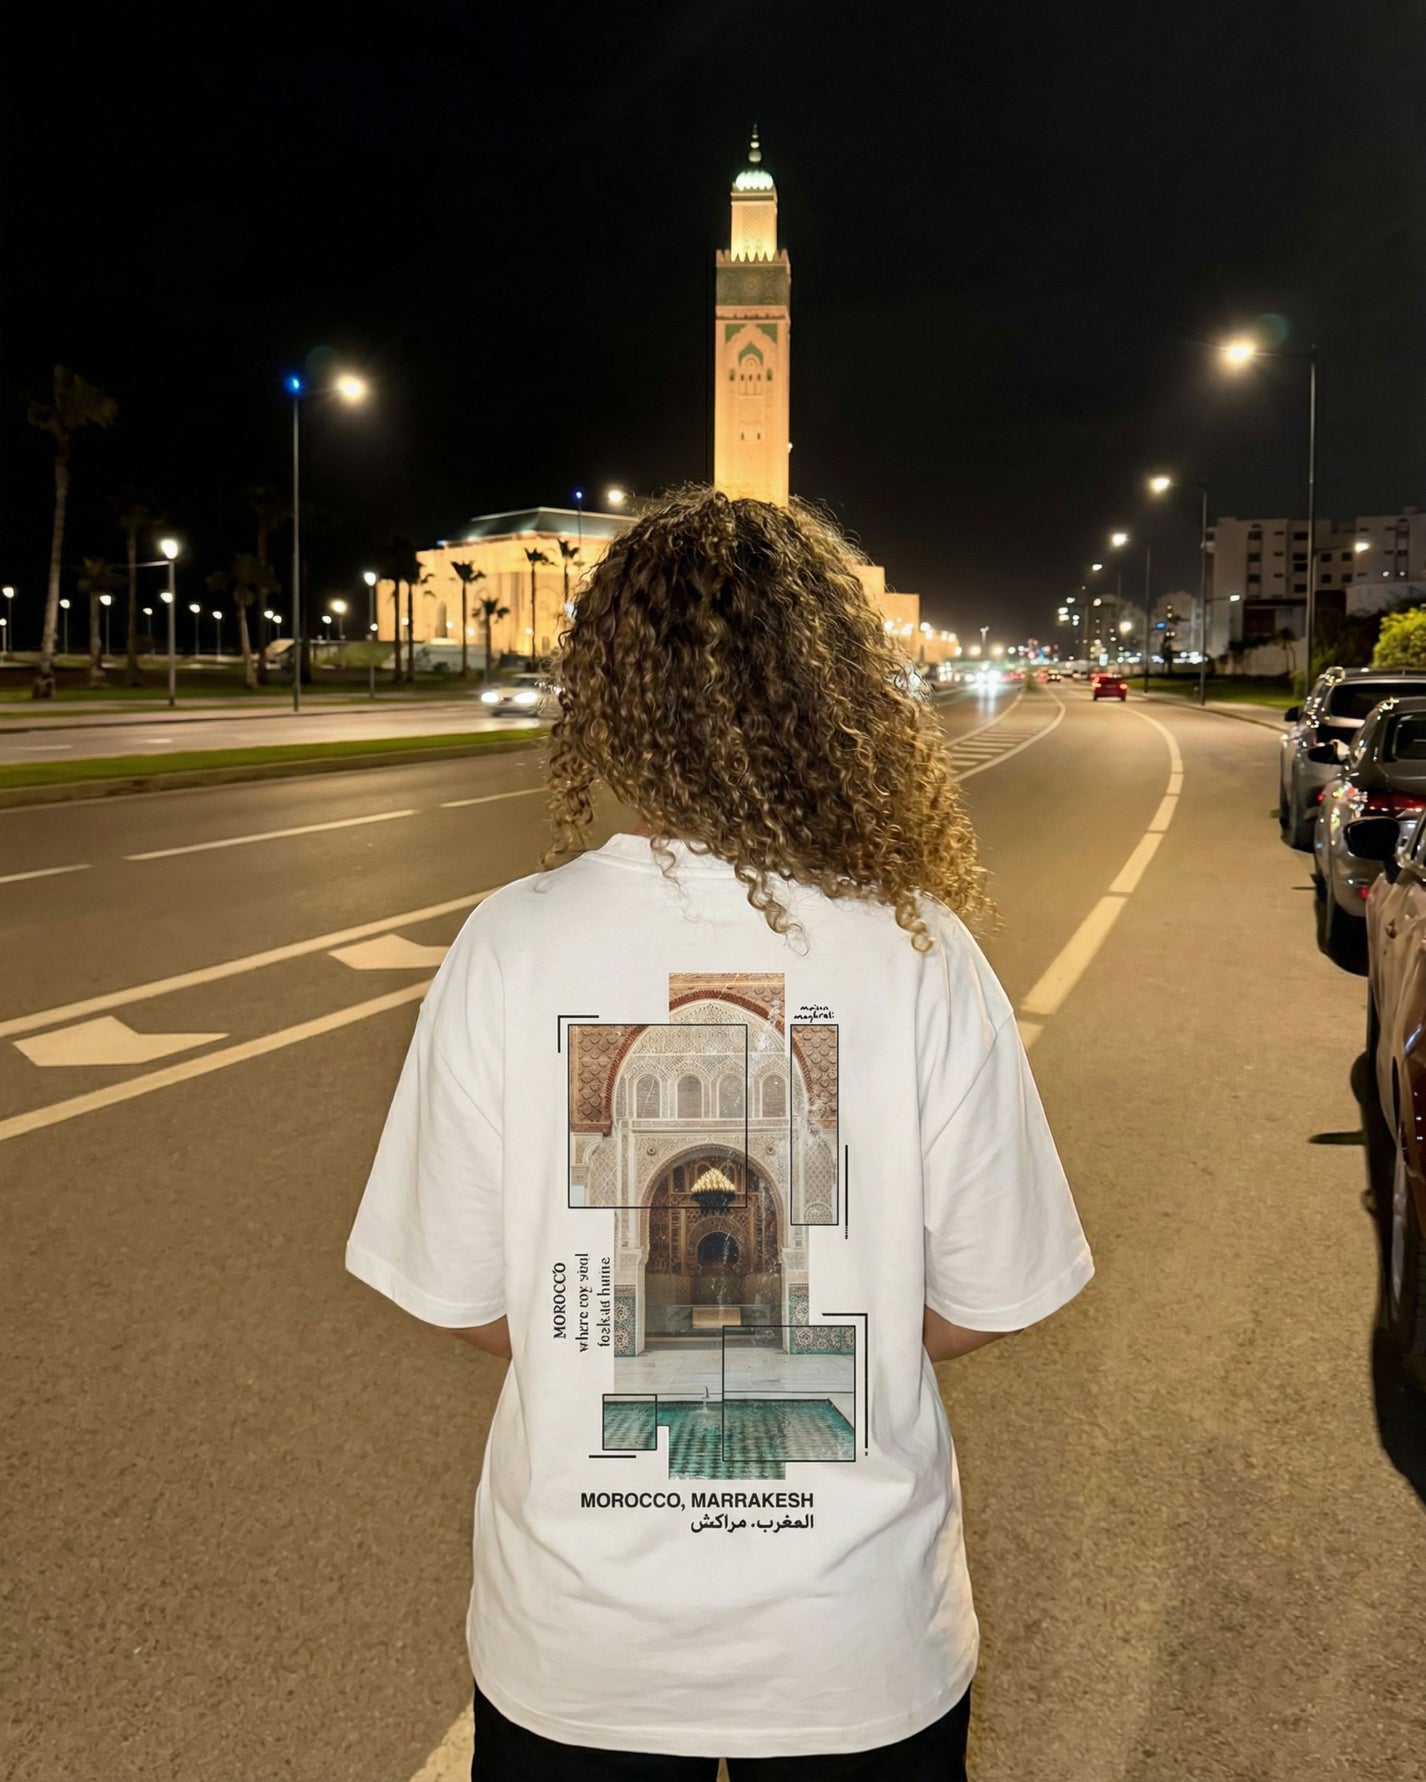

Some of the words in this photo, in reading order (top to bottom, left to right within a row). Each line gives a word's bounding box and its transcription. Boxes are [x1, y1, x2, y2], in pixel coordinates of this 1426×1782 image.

[581, 1492, 686, 1511] MOROCCO,
[691, 1492, 814, 1508] MARRAKESH
[690, 1514, 747, 1533] مراكش
